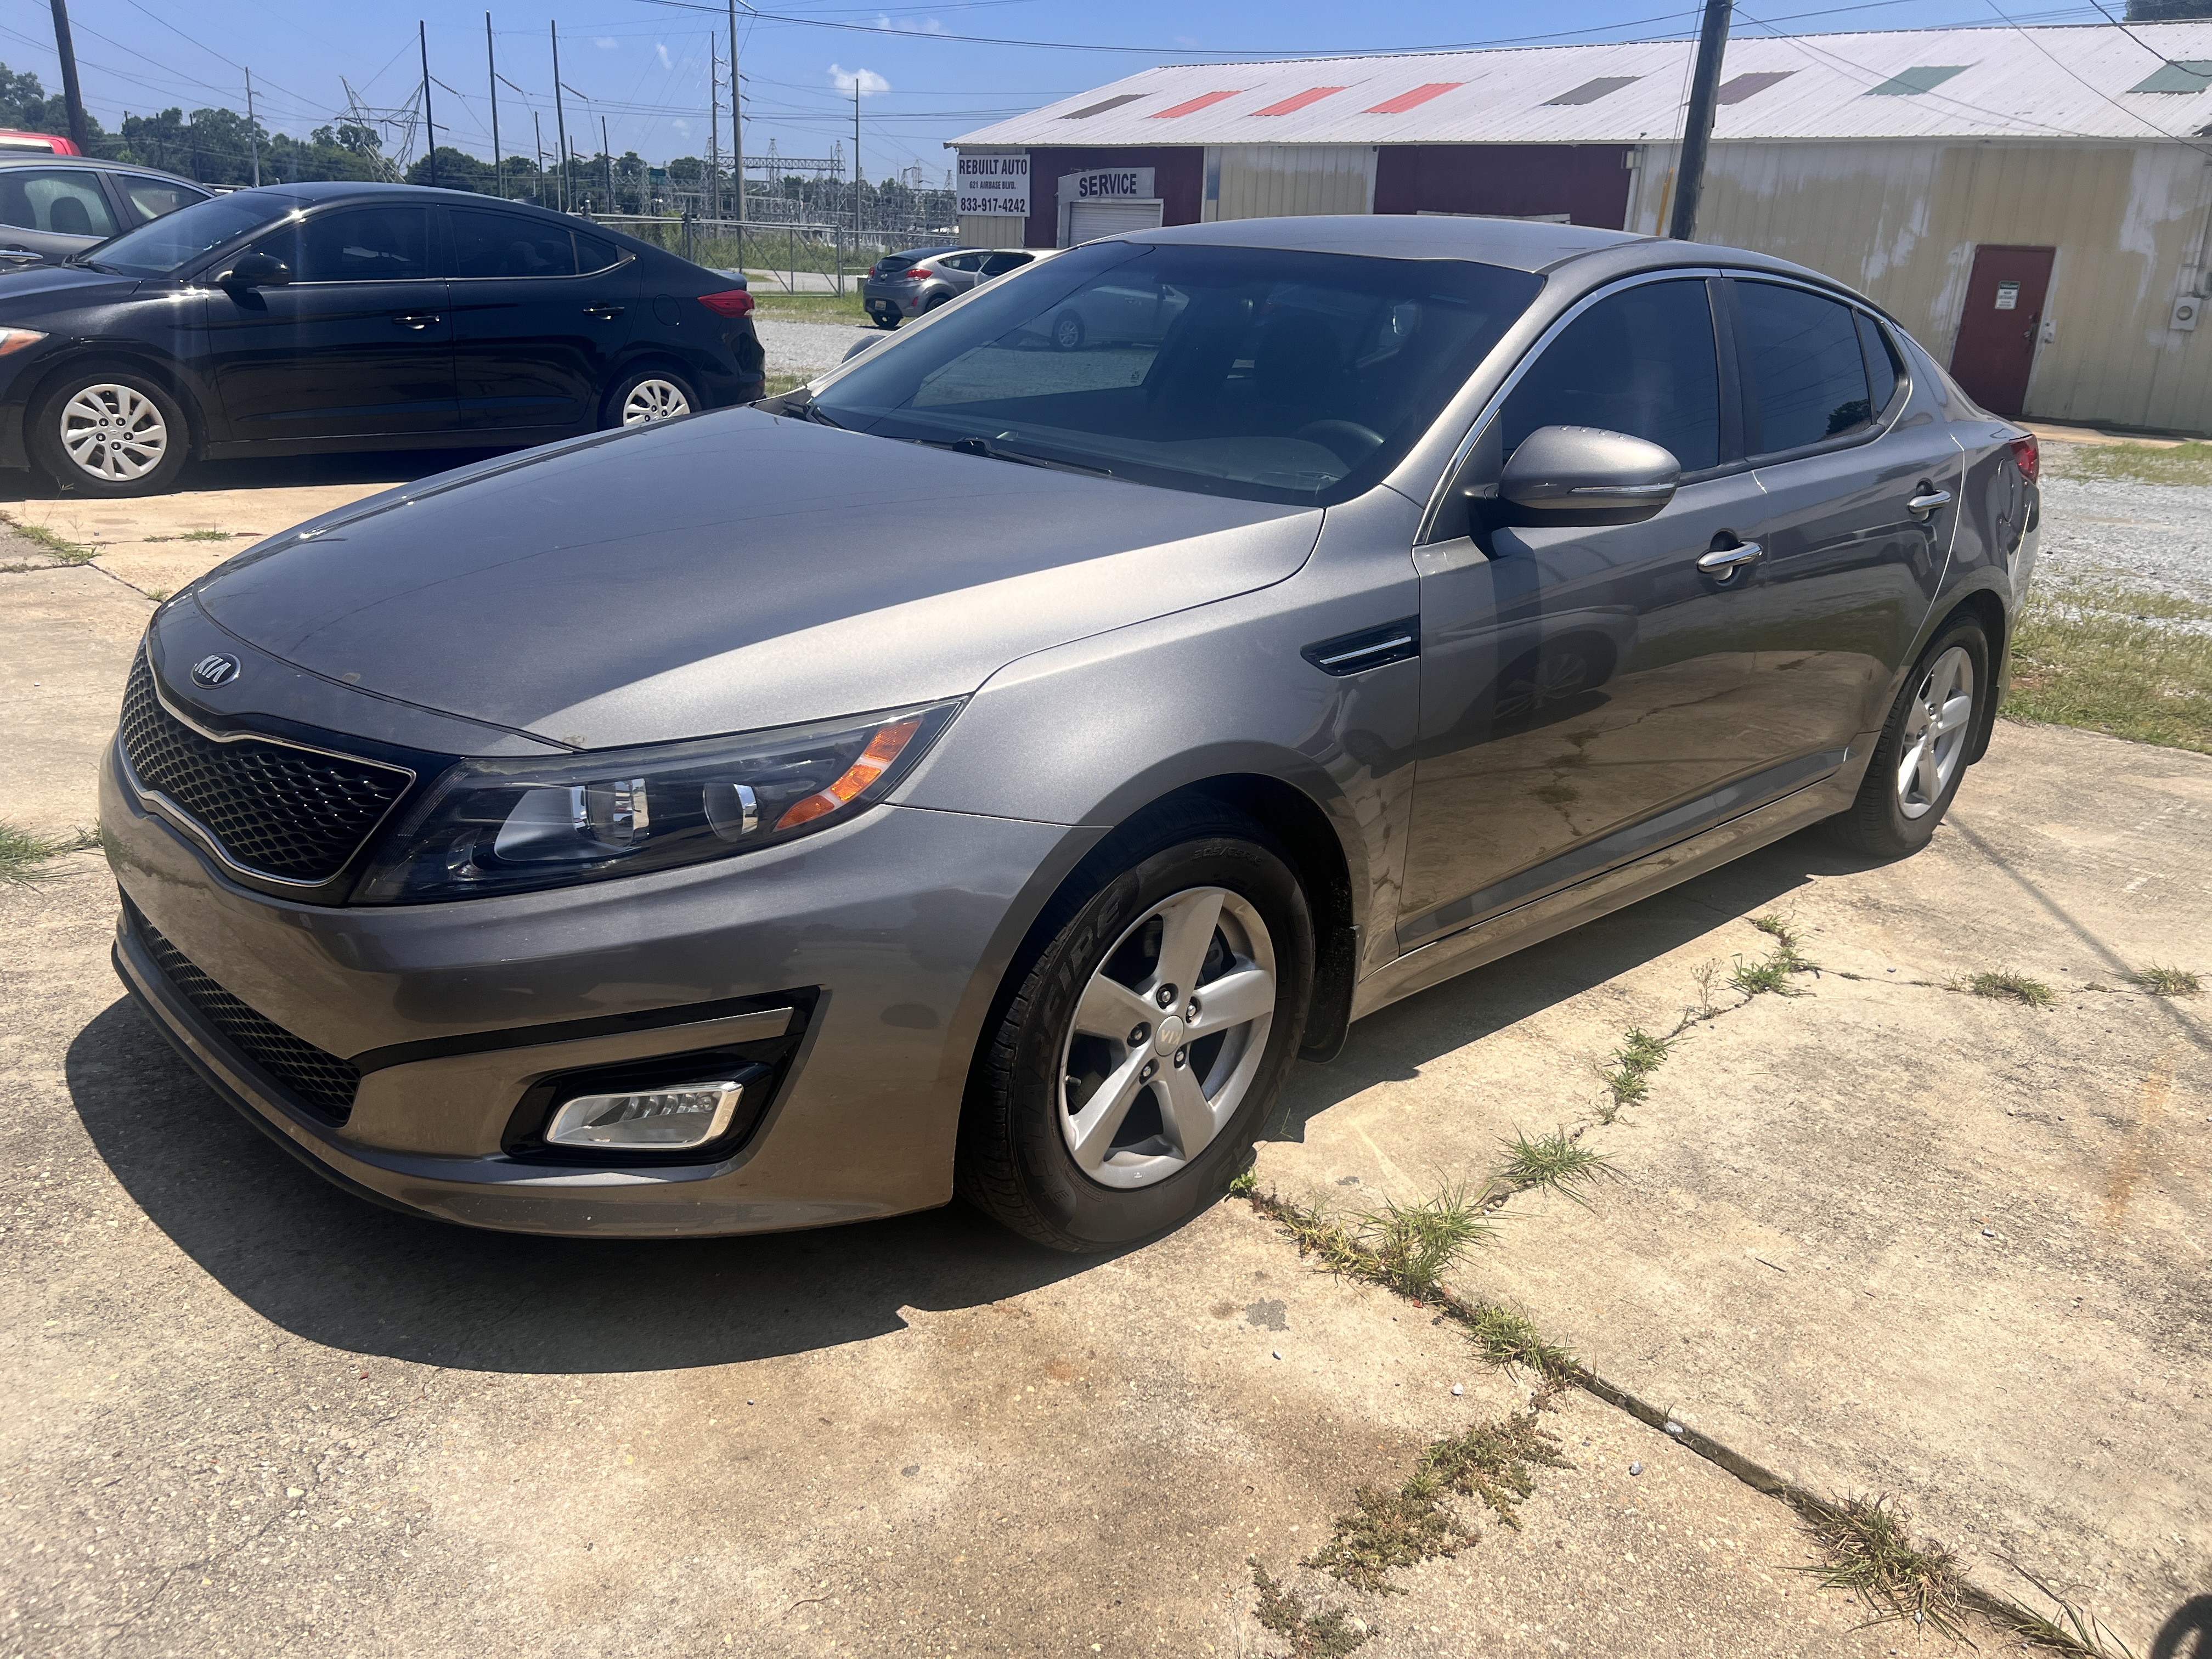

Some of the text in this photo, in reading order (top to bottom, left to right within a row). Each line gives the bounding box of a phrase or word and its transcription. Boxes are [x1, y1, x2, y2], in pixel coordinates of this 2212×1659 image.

[959, 159, 1028, 175] REBUILT AUTO
[980, 181, 1001, 189] AIRBASE
[1002, 181, 1017, 189] BLVD.
[1079, 173, 1137, 197] SERVICE
[961, 198, 1025, 213] 833-917-4242
[195, 655, 232, 682] KIA
[1161, 1029, 1182, 1045] KIA
